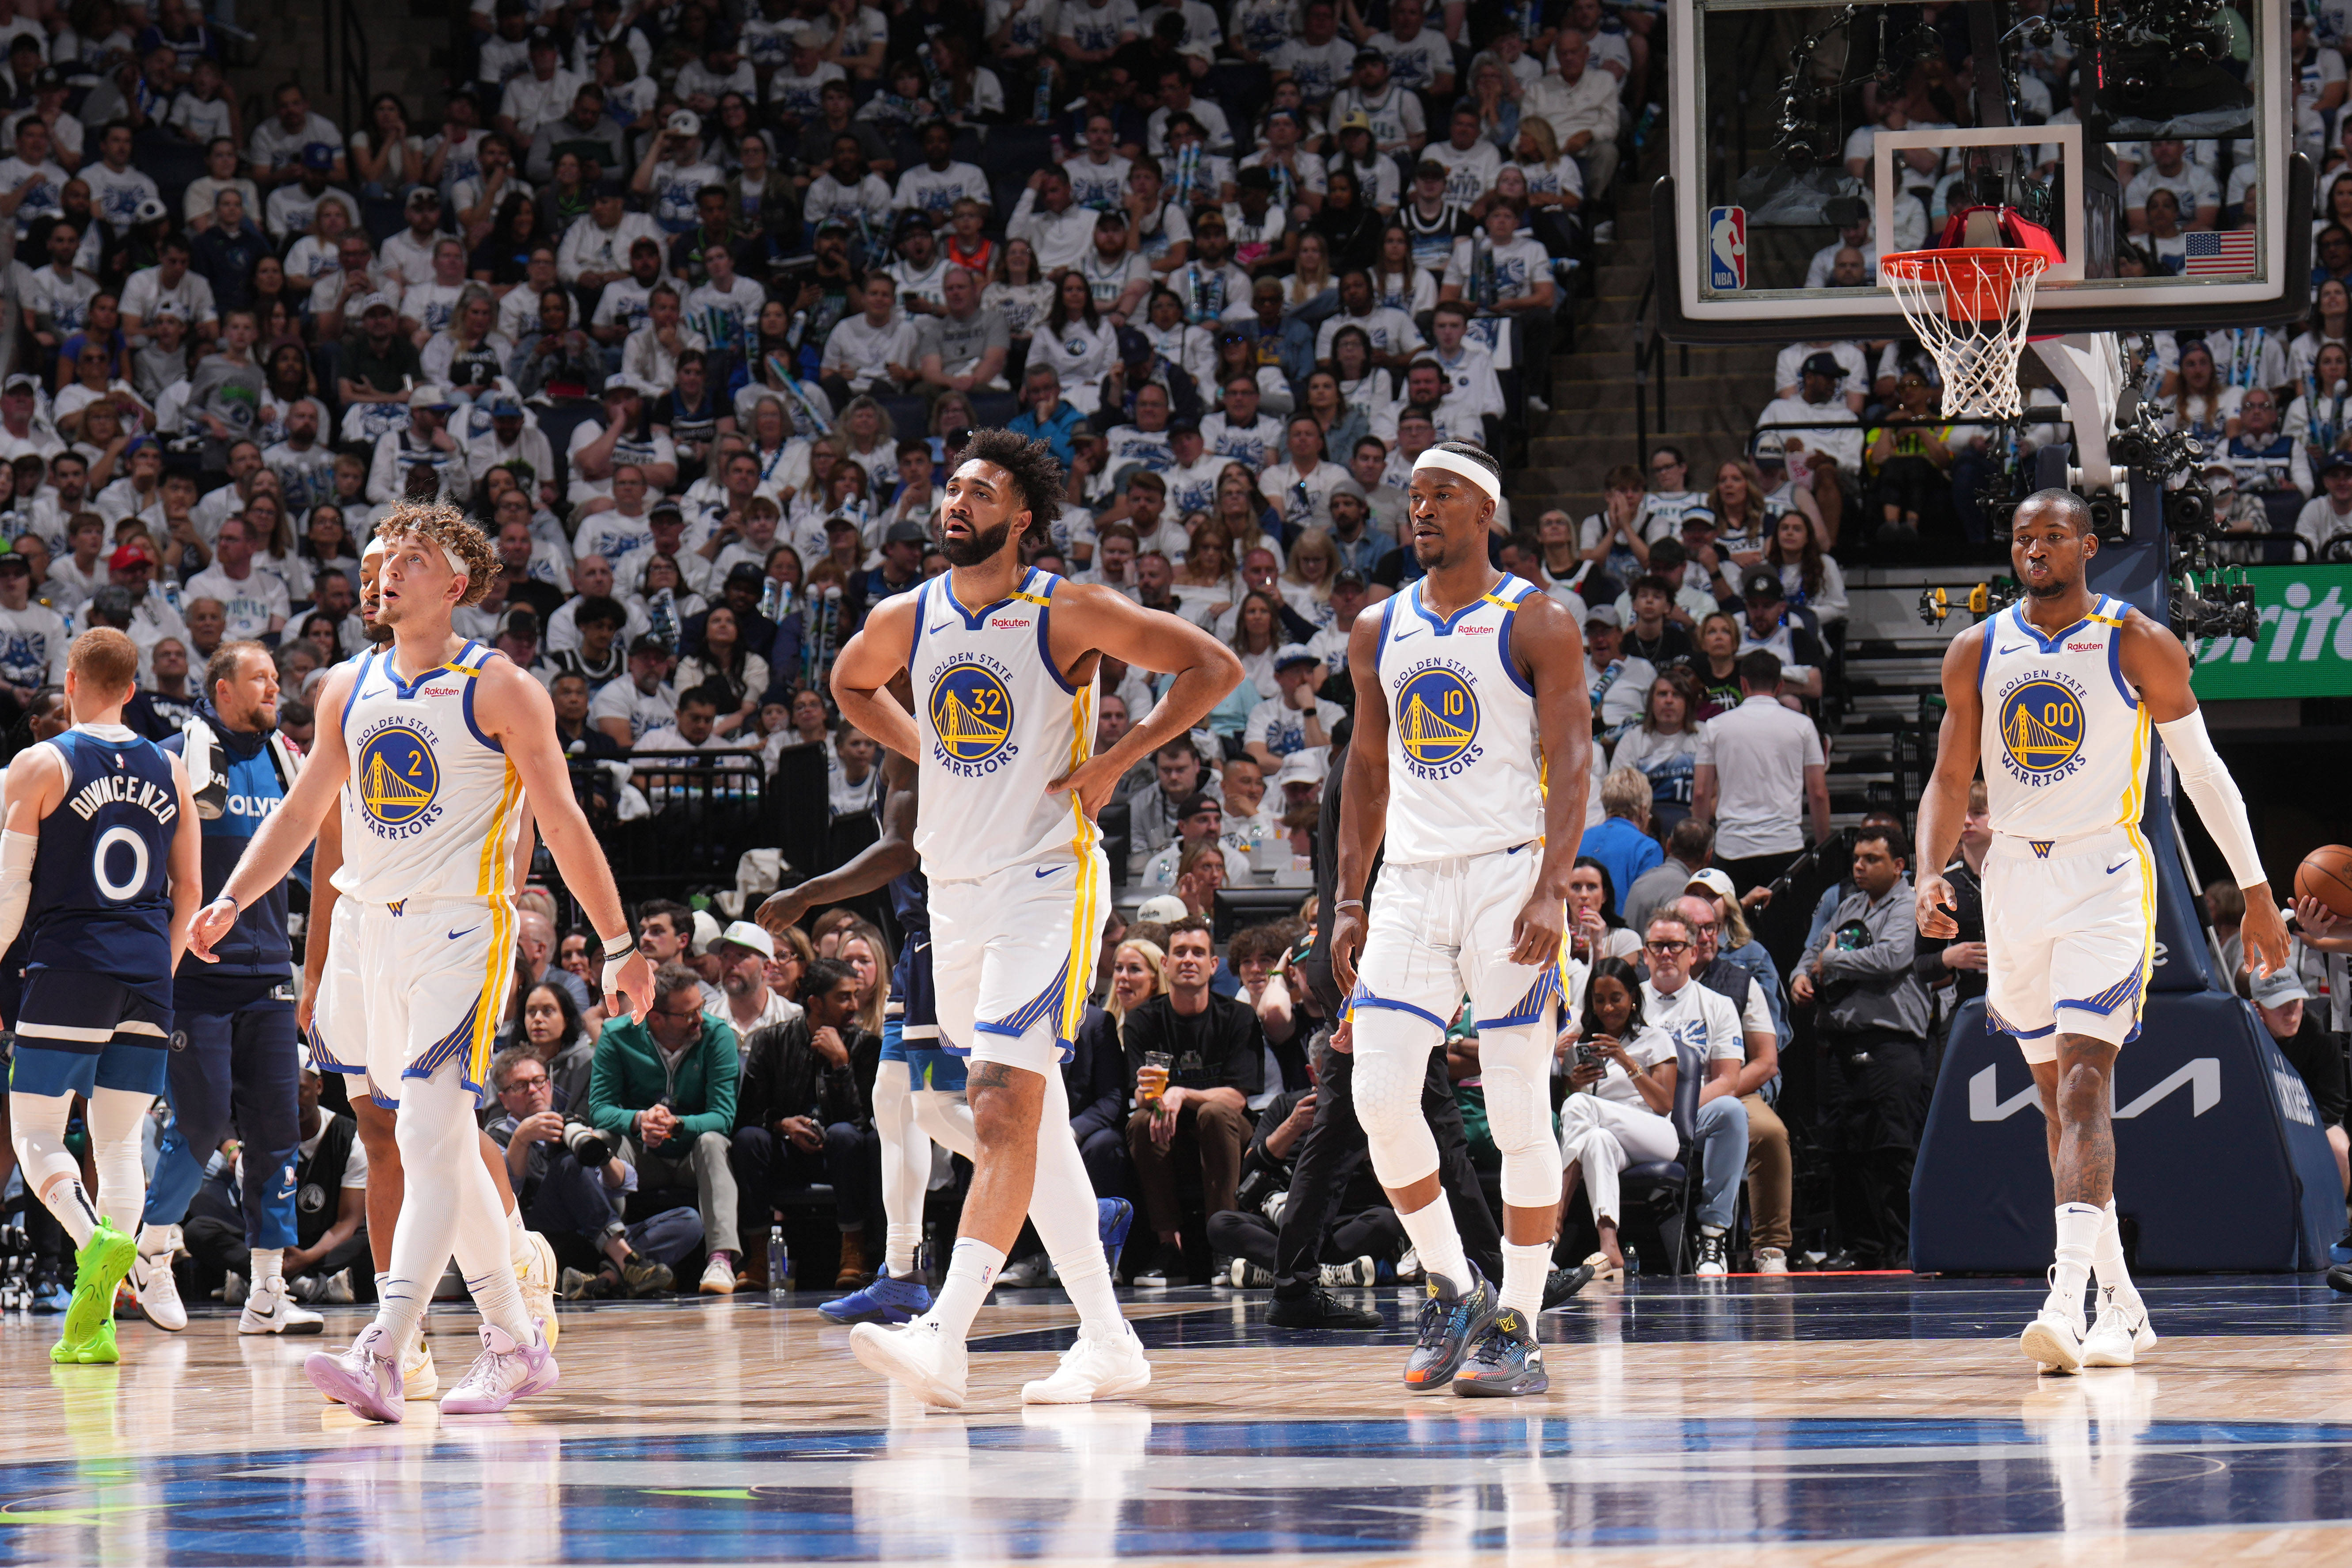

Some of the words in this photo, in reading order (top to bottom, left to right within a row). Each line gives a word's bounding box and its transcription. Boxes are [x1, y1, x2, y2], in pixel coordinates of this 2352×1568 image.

[1715, 272, 1732, 286] NBA
[992, 618, 1030, 629] Rakuten
[1458, 625, 1494, 635] Rakuten
[2067, 642, 2103, 652] Rakuten
[929, 652, 974, 684] GOLDEN
[979, 654, 1013, 683] STATE
[1393, 657, 1441, 689] GOLDEN
[1446, 659, 1478, 686] STATE
[424, 687, 459, 697] Rakuten
[1999, 670, 2049, 697] GOLDEN
[2055, 671, 2087, 699] STATE
[972, 689, 1001, 715] 32
[1444, 690, 1463, 716] 10
[2044, 702, 2074, 727] 00
[357, 715, 403, 746] GOLDEN
[408, 718, 439, 746] STATE
[408, 750, 422, 776] 2
[933, 741, 1019, 778] WARRIORS
[2002, 750, 2086, 787] WARRIORS
[69, 775, 176, 825] DIVINCENZO
[221, 794, 282, 818] OLVE
[362, 803, 443, 840] WARRIORS
[93, 825, 150, 901] 0
